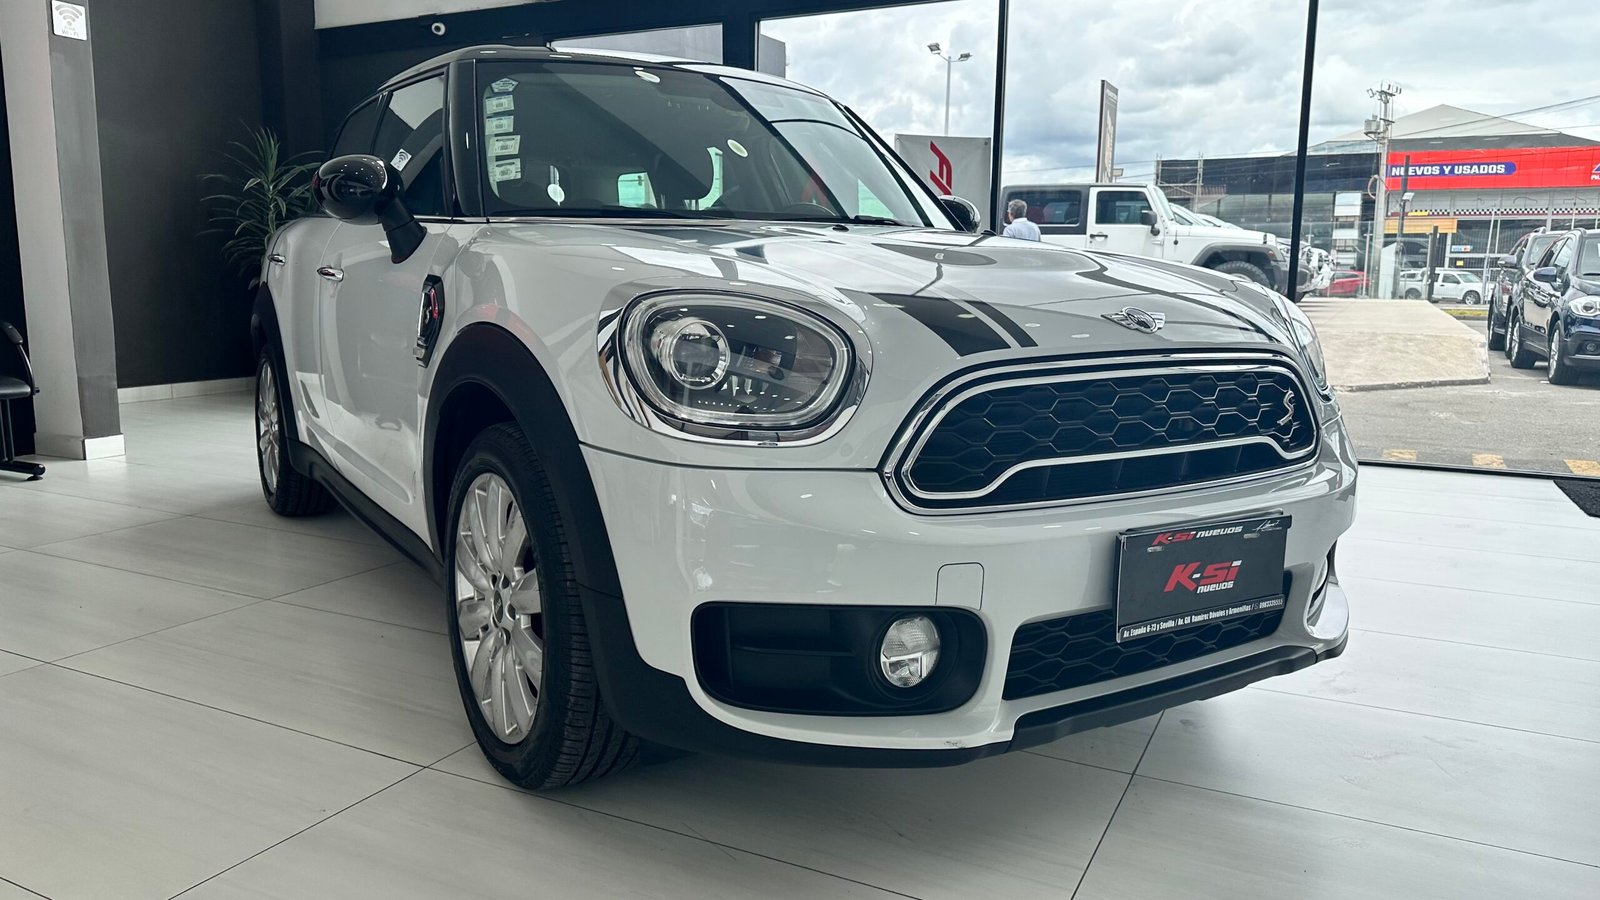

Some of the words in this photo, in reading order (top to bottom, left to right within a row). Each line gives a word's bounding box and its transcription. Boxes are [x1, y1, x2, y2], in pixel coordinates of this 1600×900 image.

[1443, 165, 1451, 175] Y
[1454, 164, 1505, 175] USADOS
[1160, 620, 1175, 630] Sevilla
